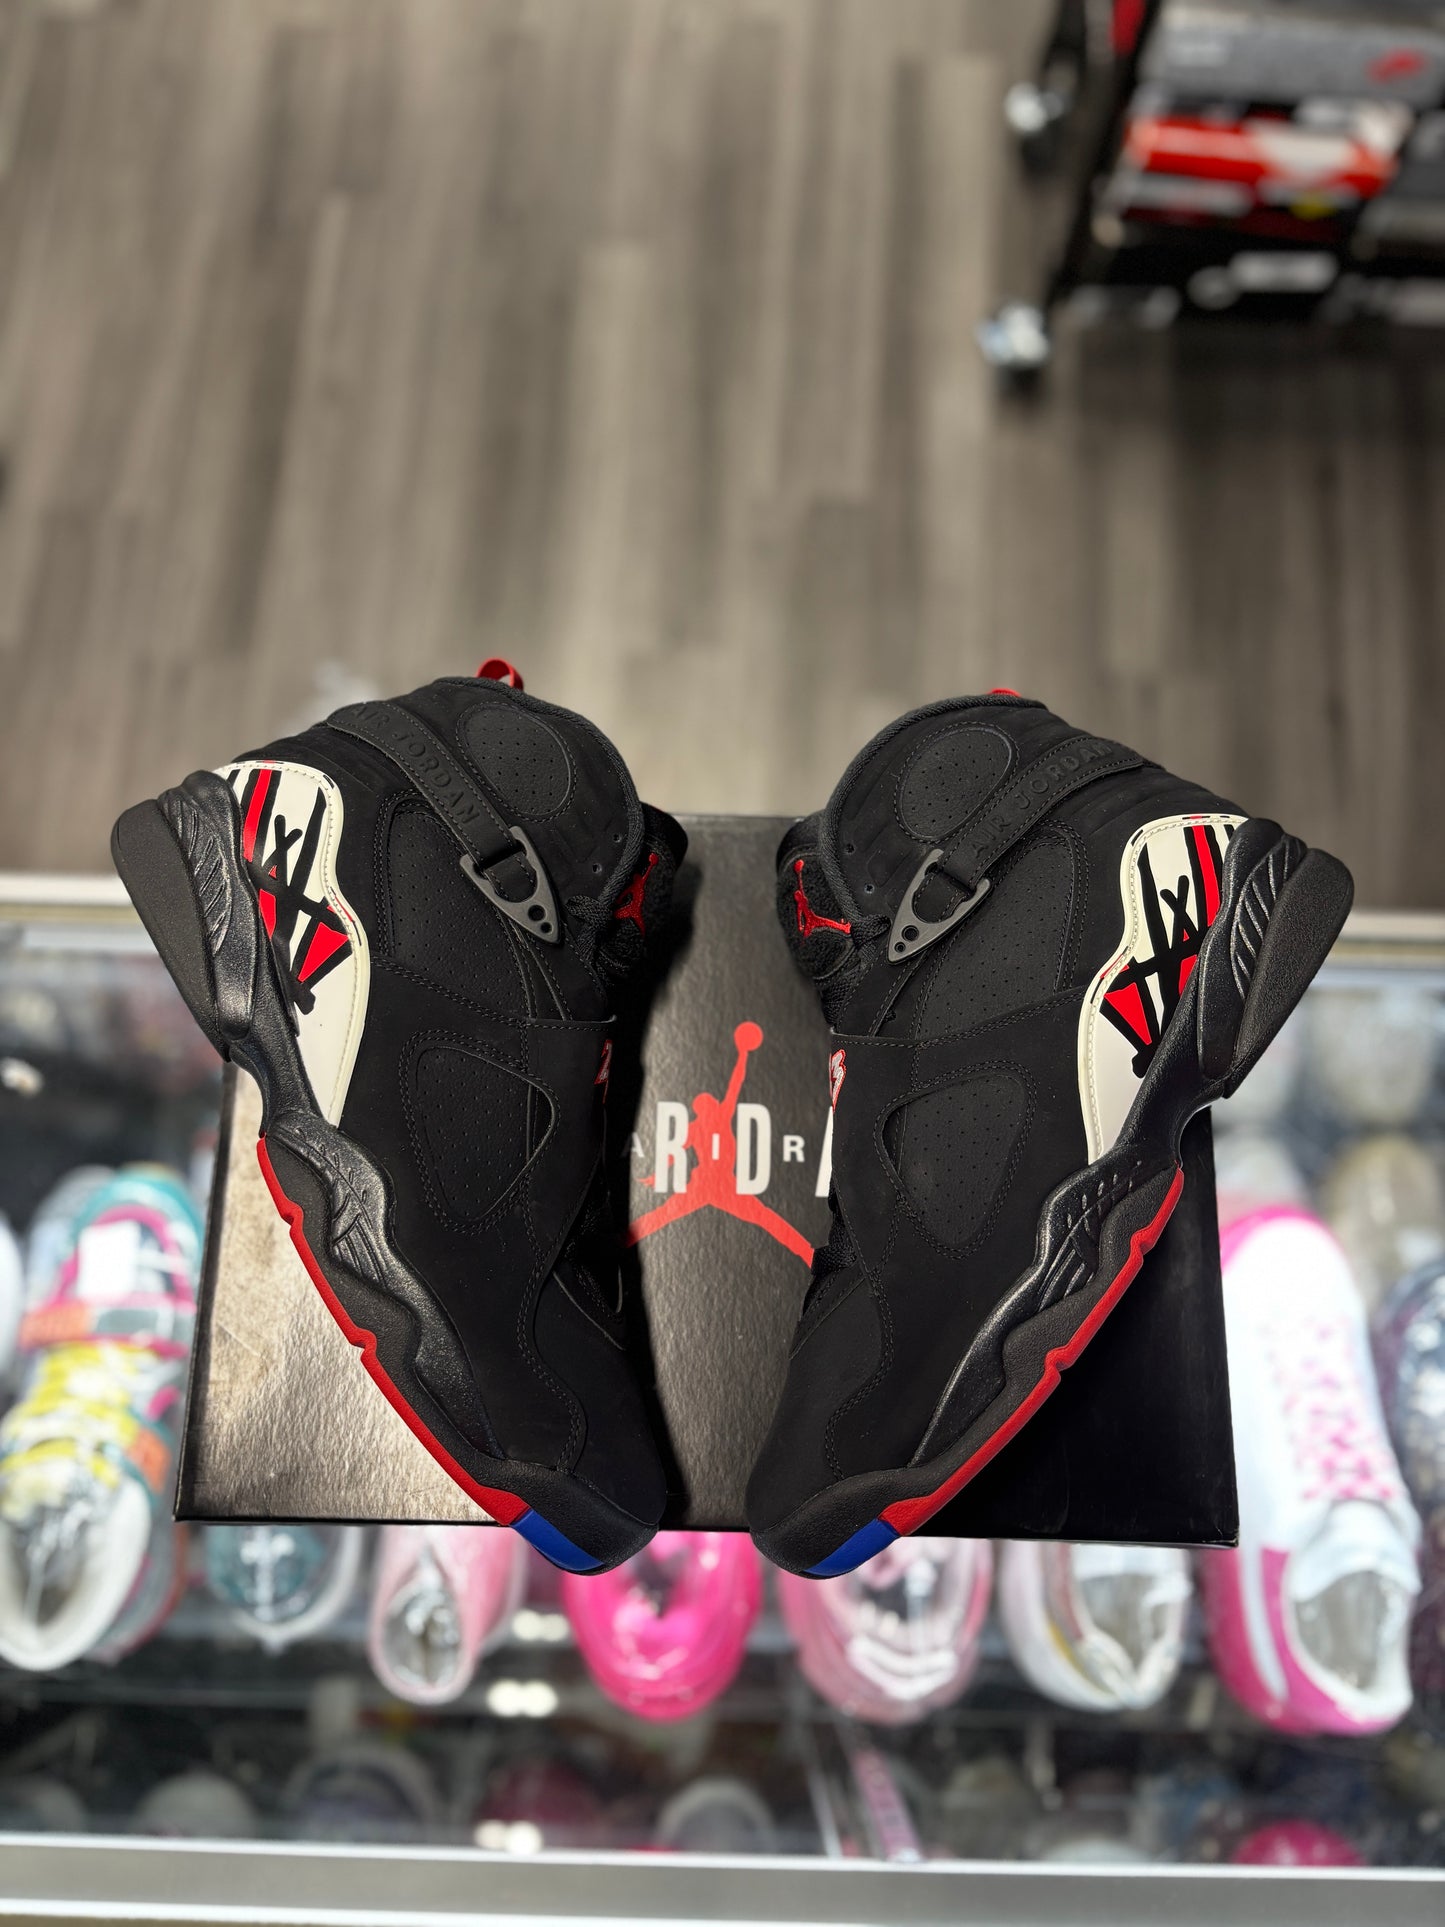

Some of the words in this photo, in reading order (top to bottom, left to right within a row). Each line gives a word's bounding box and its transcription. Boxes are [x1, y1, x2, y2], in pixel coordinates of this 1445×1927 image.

[352, 706, 390, 731] AIR
[392, 732, 481, 825] JORDAN
[971, 815, 1012, 858] AIR
[1015, 743, 1112, 809] JORDAN
